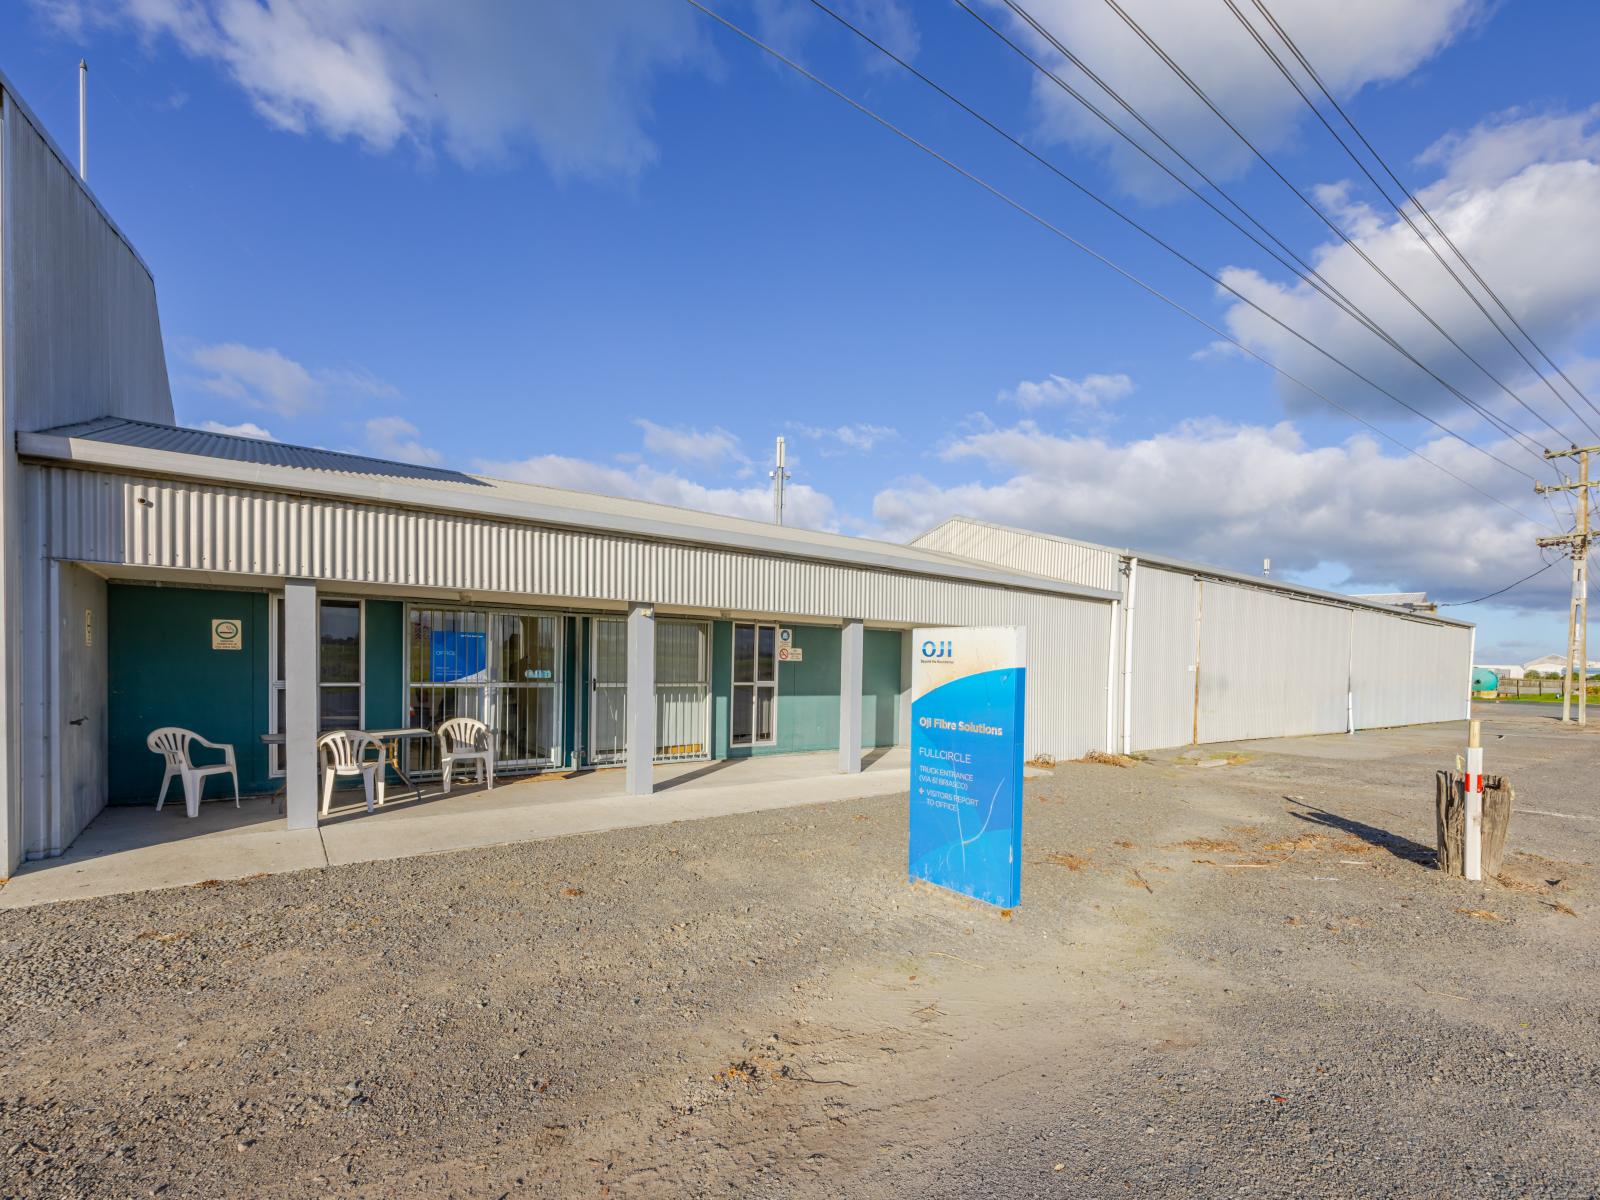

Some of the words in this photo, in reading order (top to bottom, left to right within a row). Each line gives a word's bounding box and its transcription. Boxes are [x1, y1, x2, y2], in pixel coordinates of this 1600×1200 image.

[921, 640, 953, 658] OJI
[919, 717, 932, 729] Oji
[934, 719, 956, 730] Fibre
[958, 721, 1003, 736] Solutions
[920, 765, 939, 774] TRUCK
[940, 769, 974, 781] ENTRANCE
[953, 795, 979, 806] REPORT
